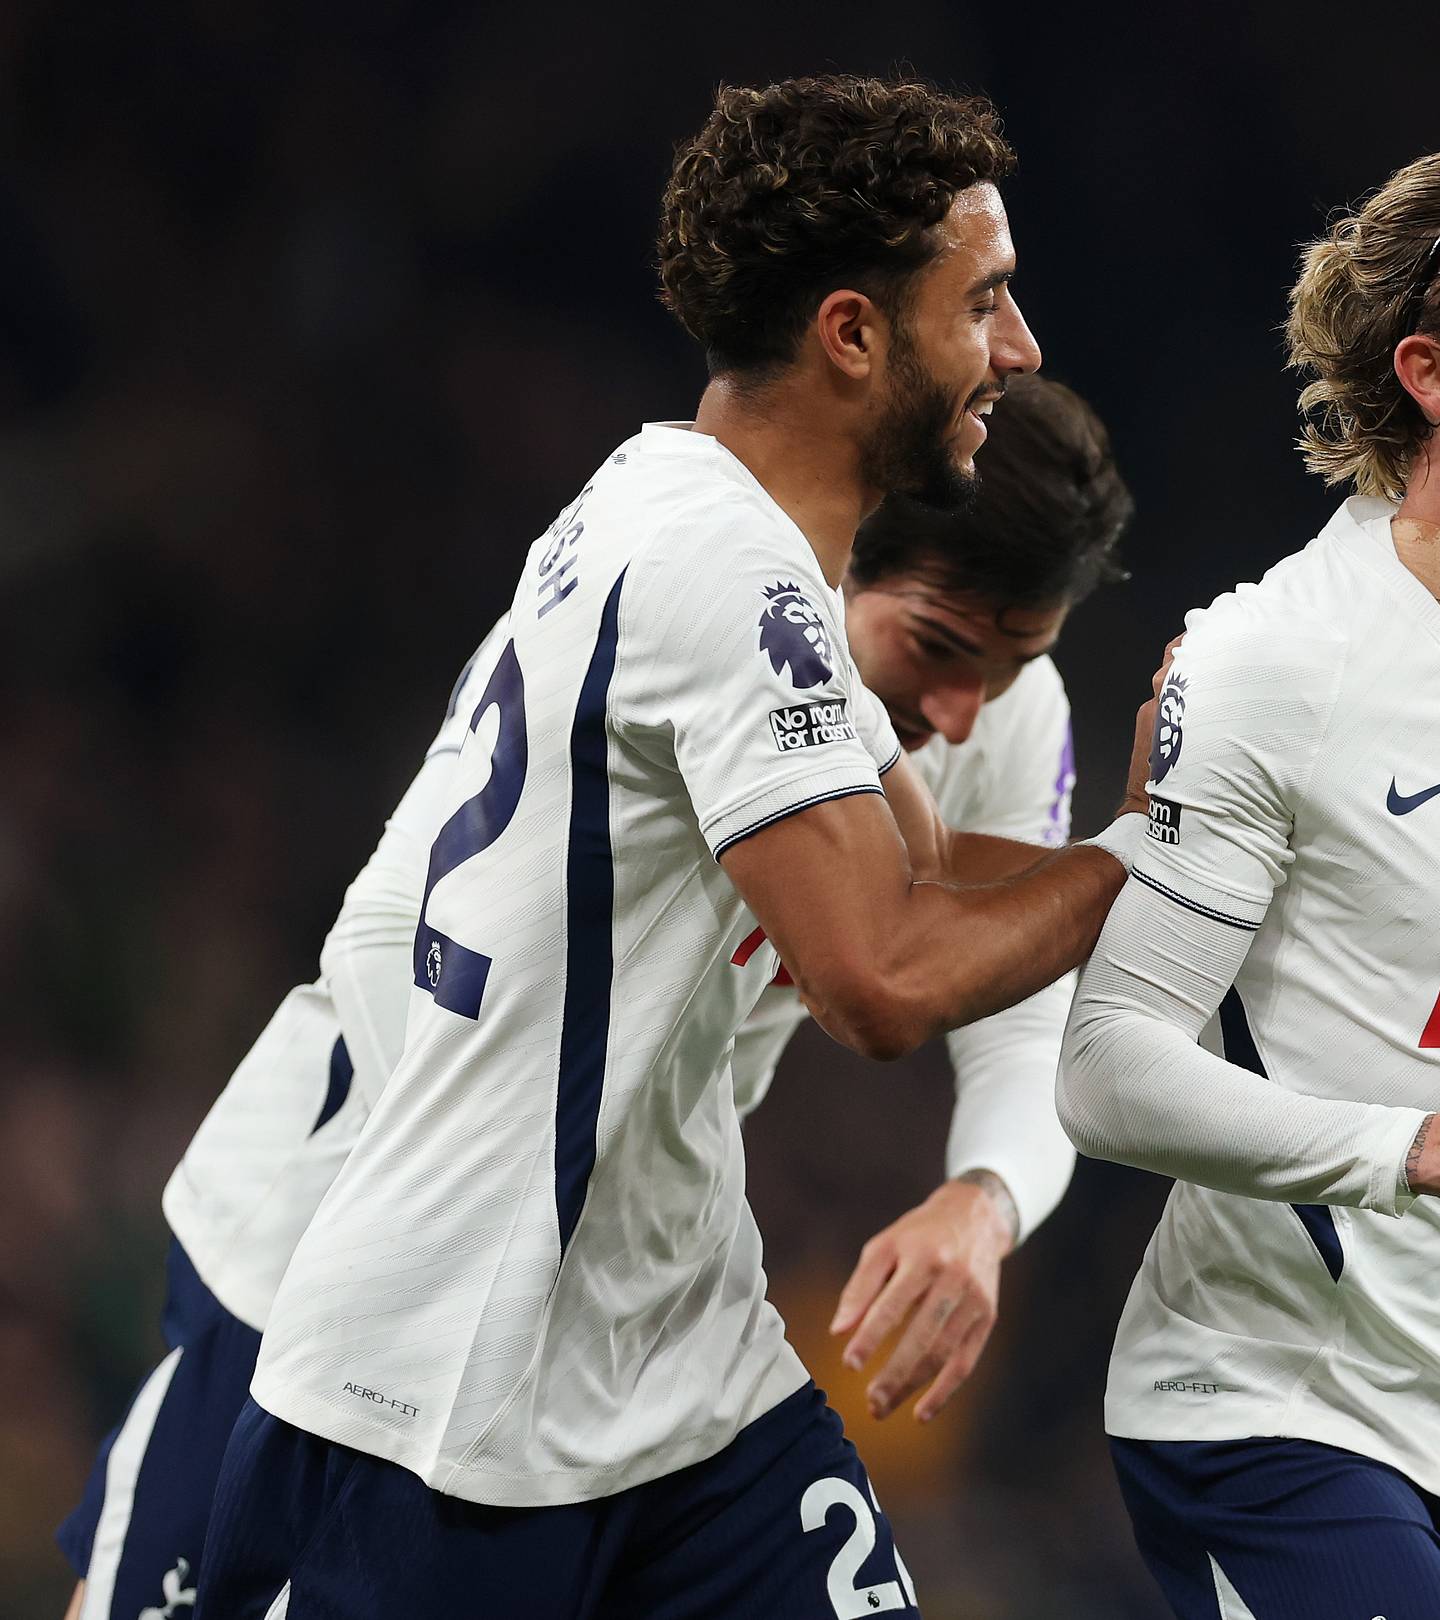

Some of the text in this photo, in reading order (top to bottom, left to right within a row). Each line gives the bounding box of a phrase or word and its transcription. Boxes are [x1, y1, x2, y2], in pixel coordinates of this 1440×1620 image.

[770, 704, 843, 733] No room
[775, 728, 809, 751] for
[1148, 799, 1171, 823] om
[343, 1381, 421, 1417] AERO-FIT
[1153, 1380, 1219, 1394] AERO-FIT
[800, 1476, 918, 1620] 2
